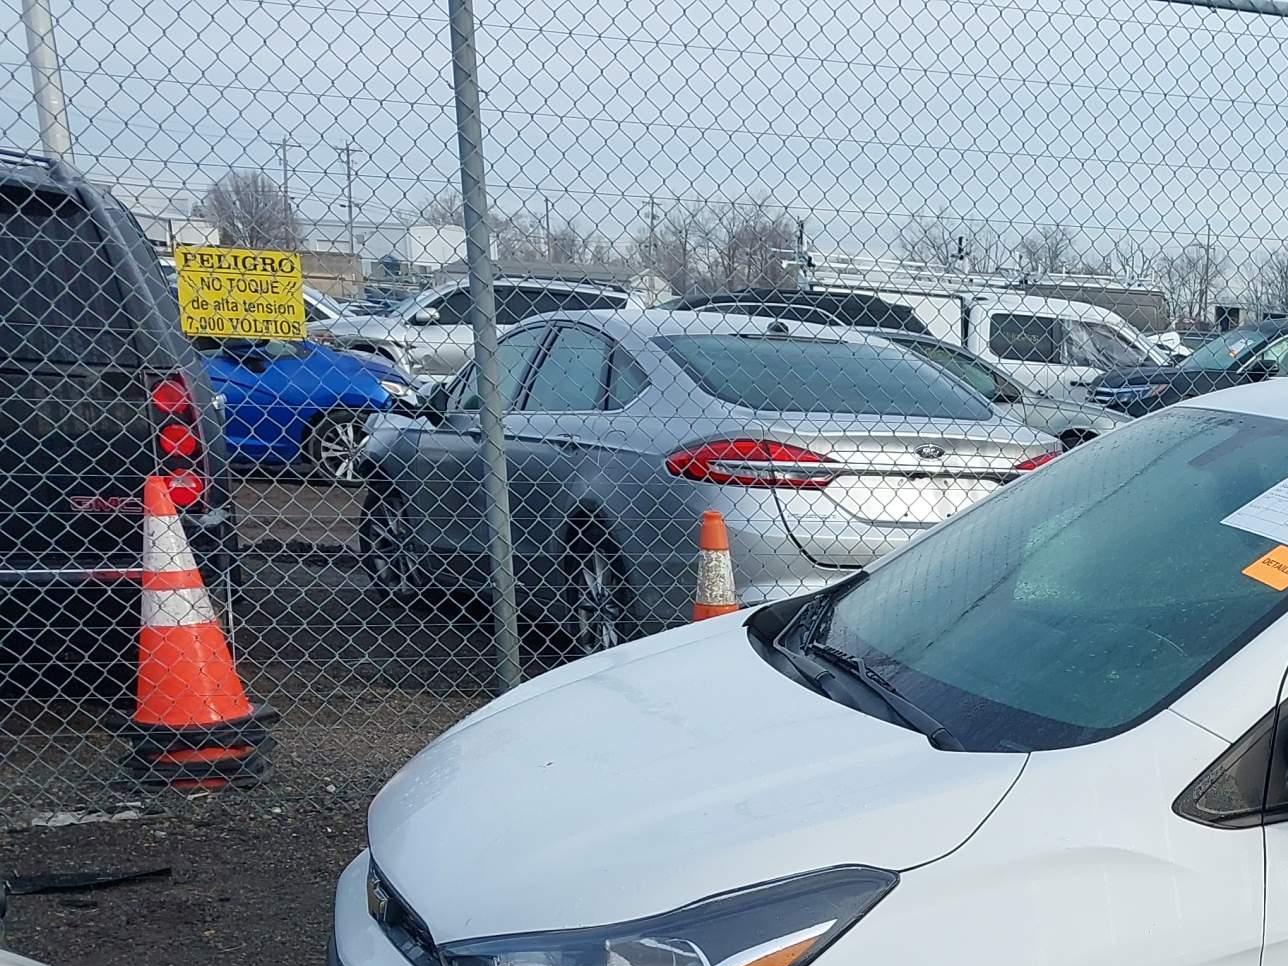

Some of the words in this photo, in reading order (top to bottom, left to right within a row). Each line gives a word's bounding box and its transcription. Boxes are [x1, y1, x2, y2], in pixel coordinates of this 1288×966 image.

[182, 252, 295, 273] PELIGRO
[200, 277, 222, 291] NO
[226, 278, 280, 294] TOQUE
[191, 297, 208, 310] de
[213, 299, 238, 312] alta
[243, 300, 295, 315] tension
[186, 316, 224, 334] 7,000
[229, 318, 301, 335] VOLTIOS
[70, 496, 143, 512] GMC
